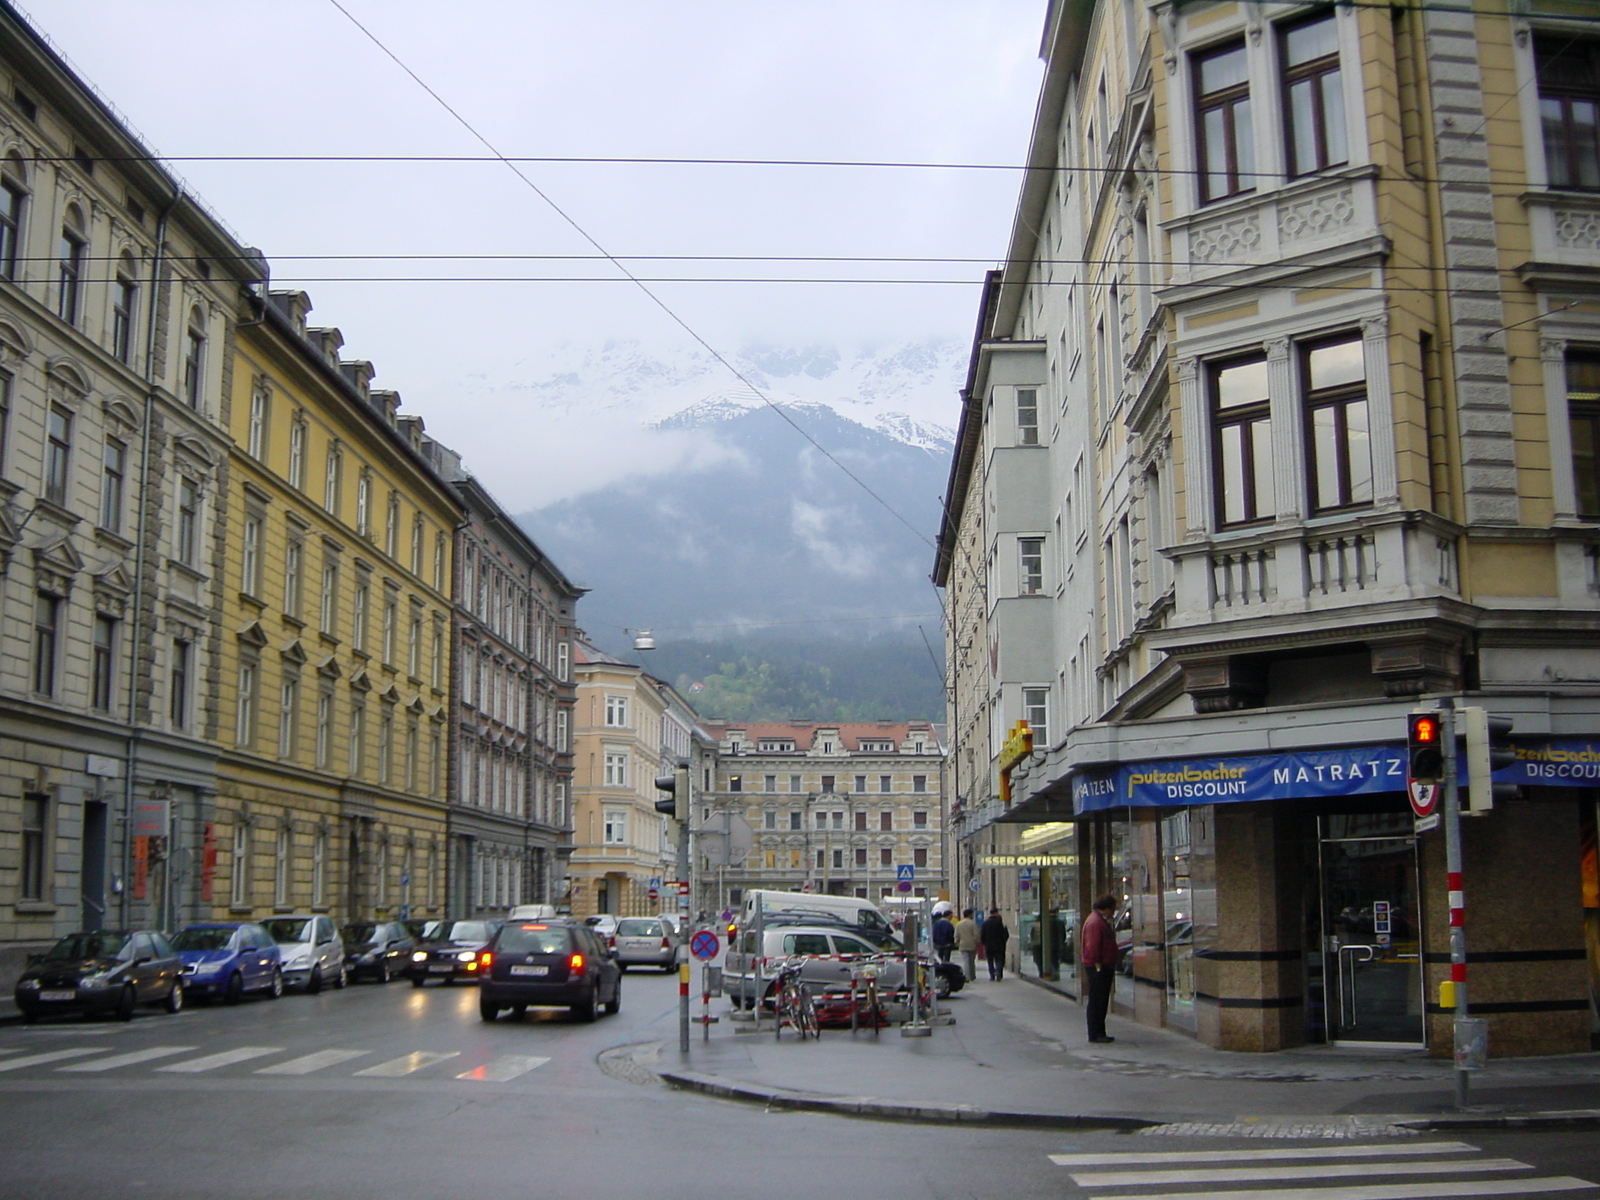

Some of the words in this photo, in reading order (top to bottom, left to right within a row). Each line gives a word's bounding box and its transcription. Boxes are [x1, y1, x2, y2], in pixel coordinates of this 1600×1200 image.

[1128, 762, 1248, 798] putzenbacher
[1273, 759, 1402, 785] MATRATZ
[1526, 763, 1600, 778] DISCOU
[1167, 781, 1248, 798] DISCOUNT
